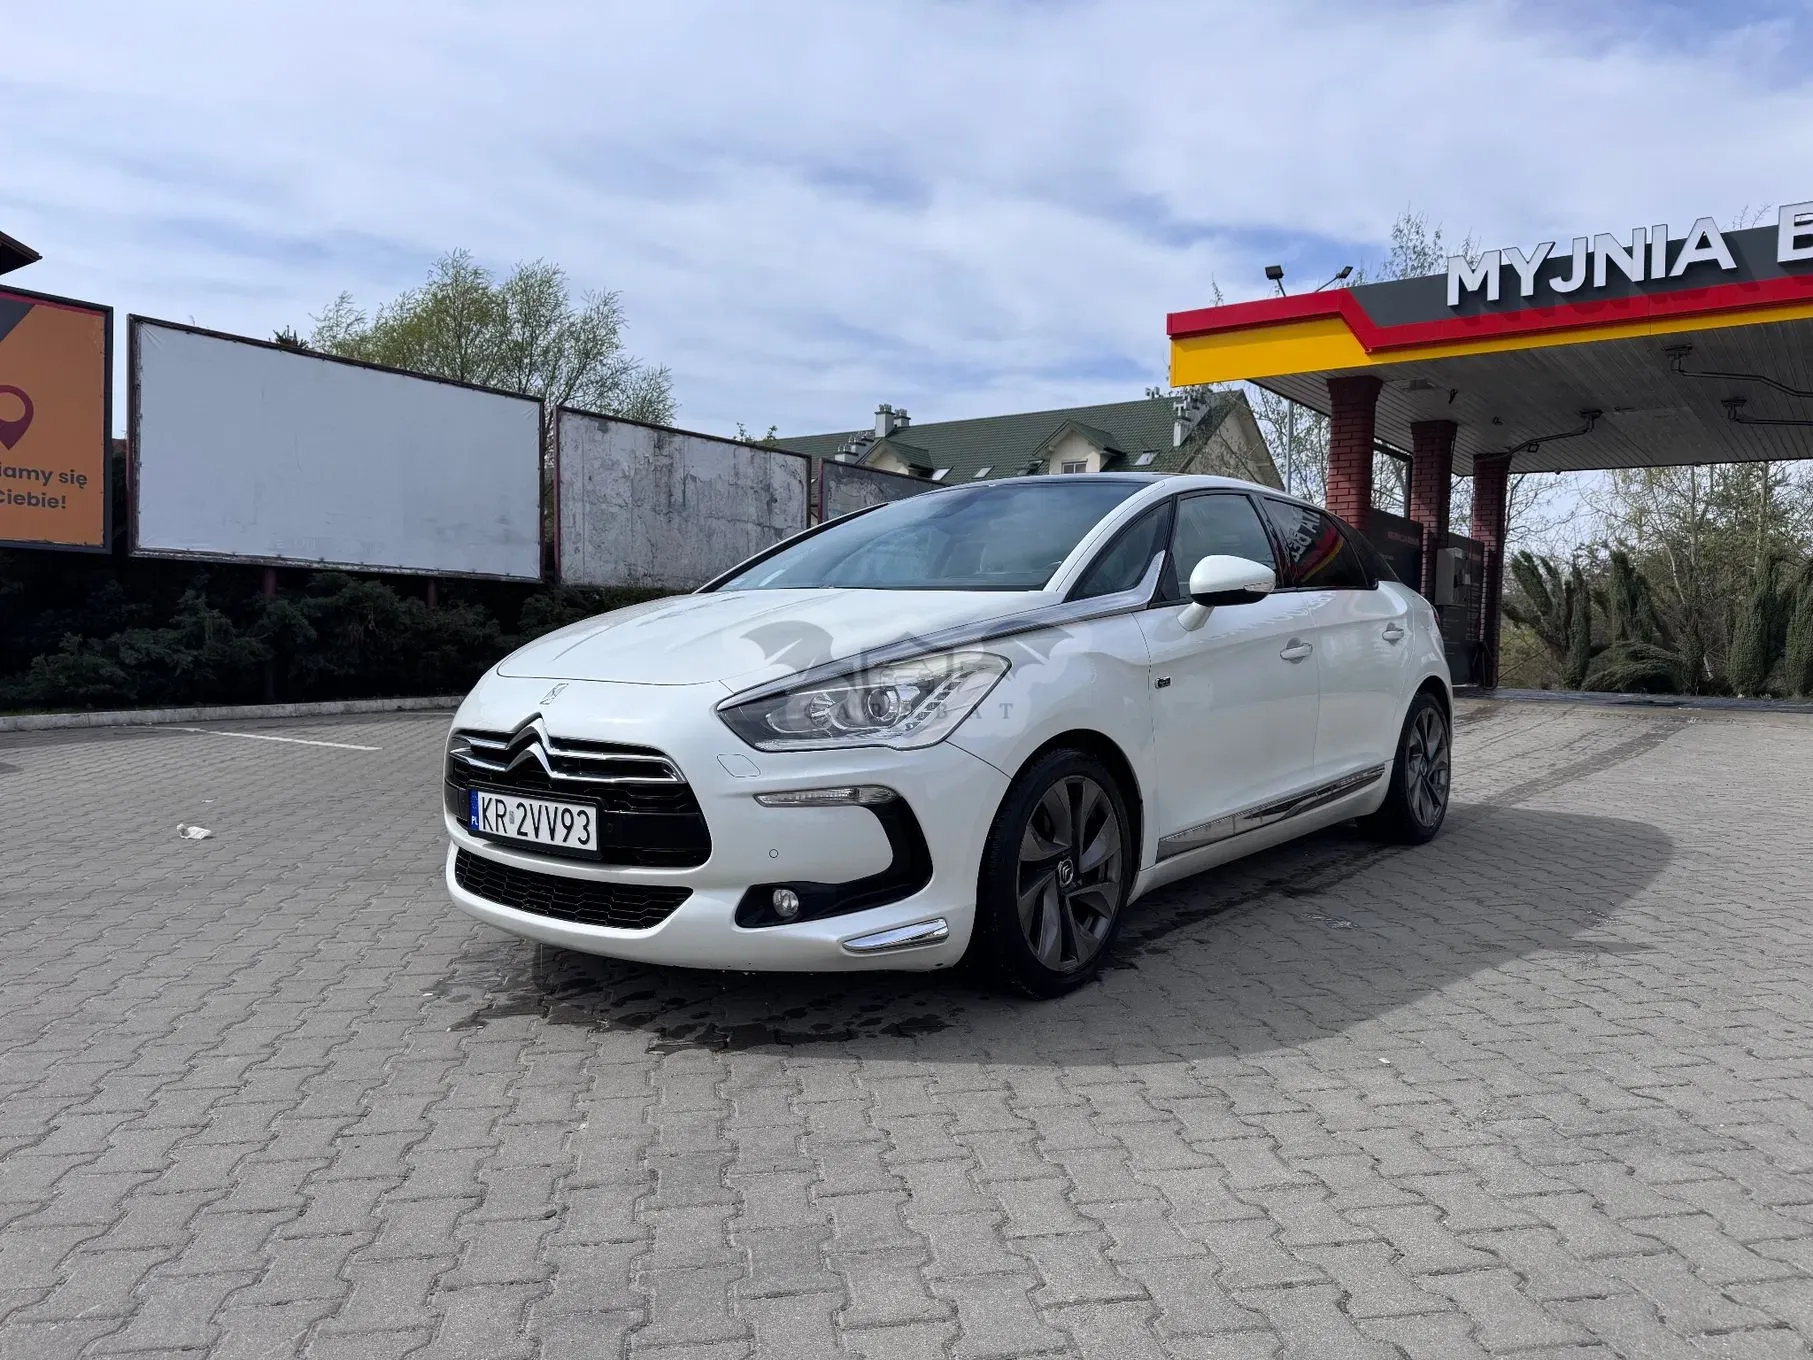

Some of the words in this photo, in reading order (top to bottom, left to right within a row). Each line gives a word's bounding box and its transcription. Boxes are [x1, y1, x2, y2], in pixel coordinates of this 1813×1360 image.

[1447, 216, 1737, 306] MYJNIA
[58, 468, 88, 490] się
[471, 816, 479, 826] PL
[482, 796, 508, 834] KR
[515, 801, 591, 846] 2VV93
